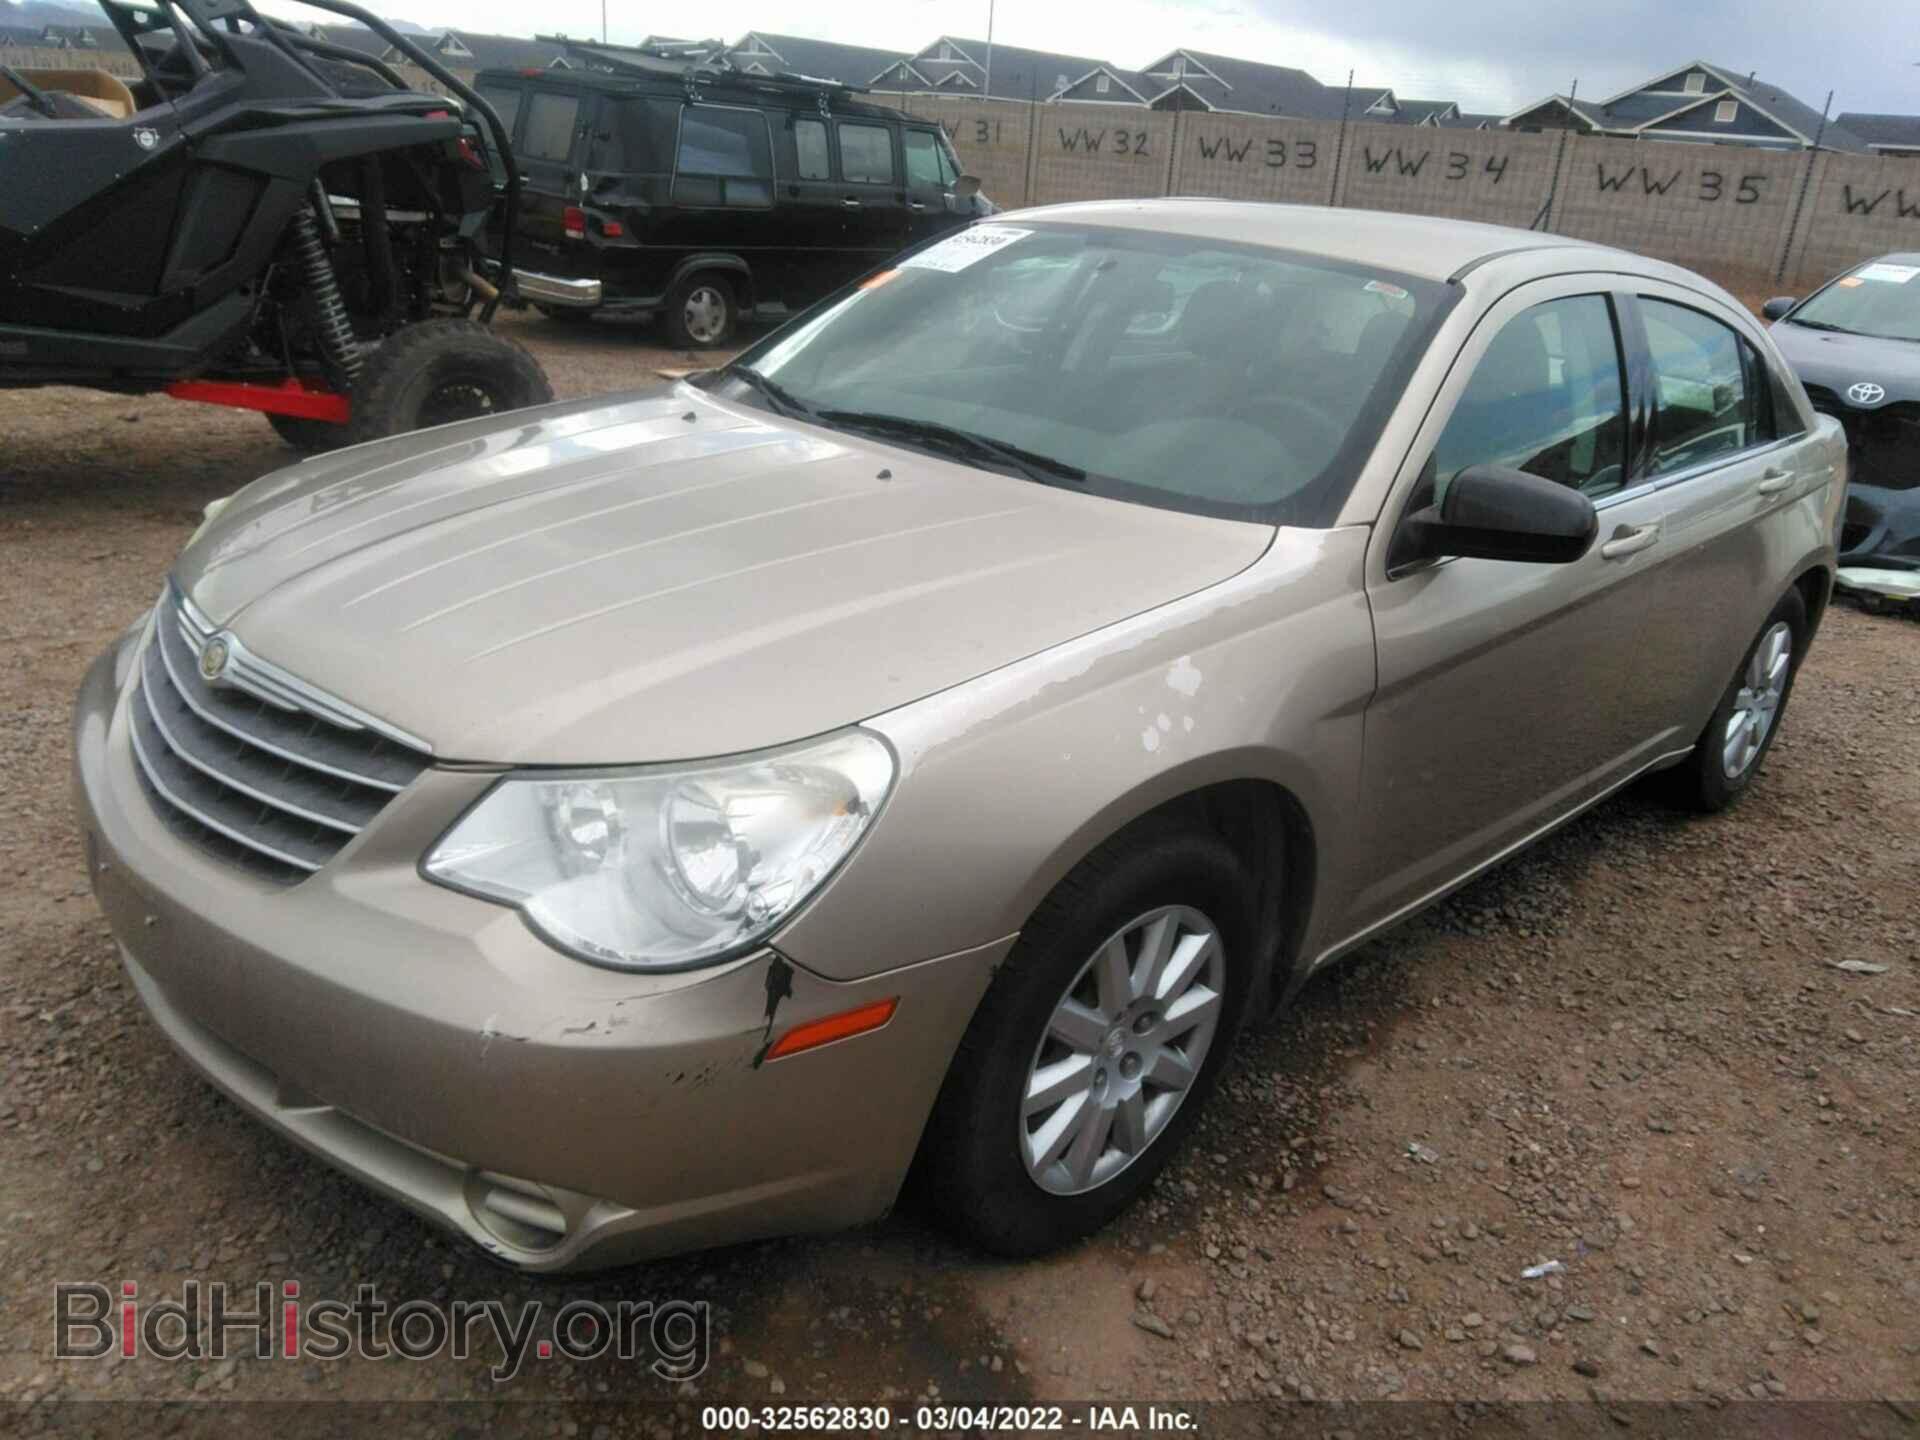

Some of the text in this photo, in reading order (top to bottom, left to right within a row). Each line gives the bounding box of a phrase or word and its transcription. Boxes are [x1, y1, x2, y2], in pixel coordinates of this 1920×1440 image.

[975, 120, 1000, 144] 31
[1057, 129, 1150, 156] WW 32
[1199, 136, 1317, 168] WW 33
[1365, 147, 1508, 184] WW 34
[1598, 163, 1768, 204] WW 35
